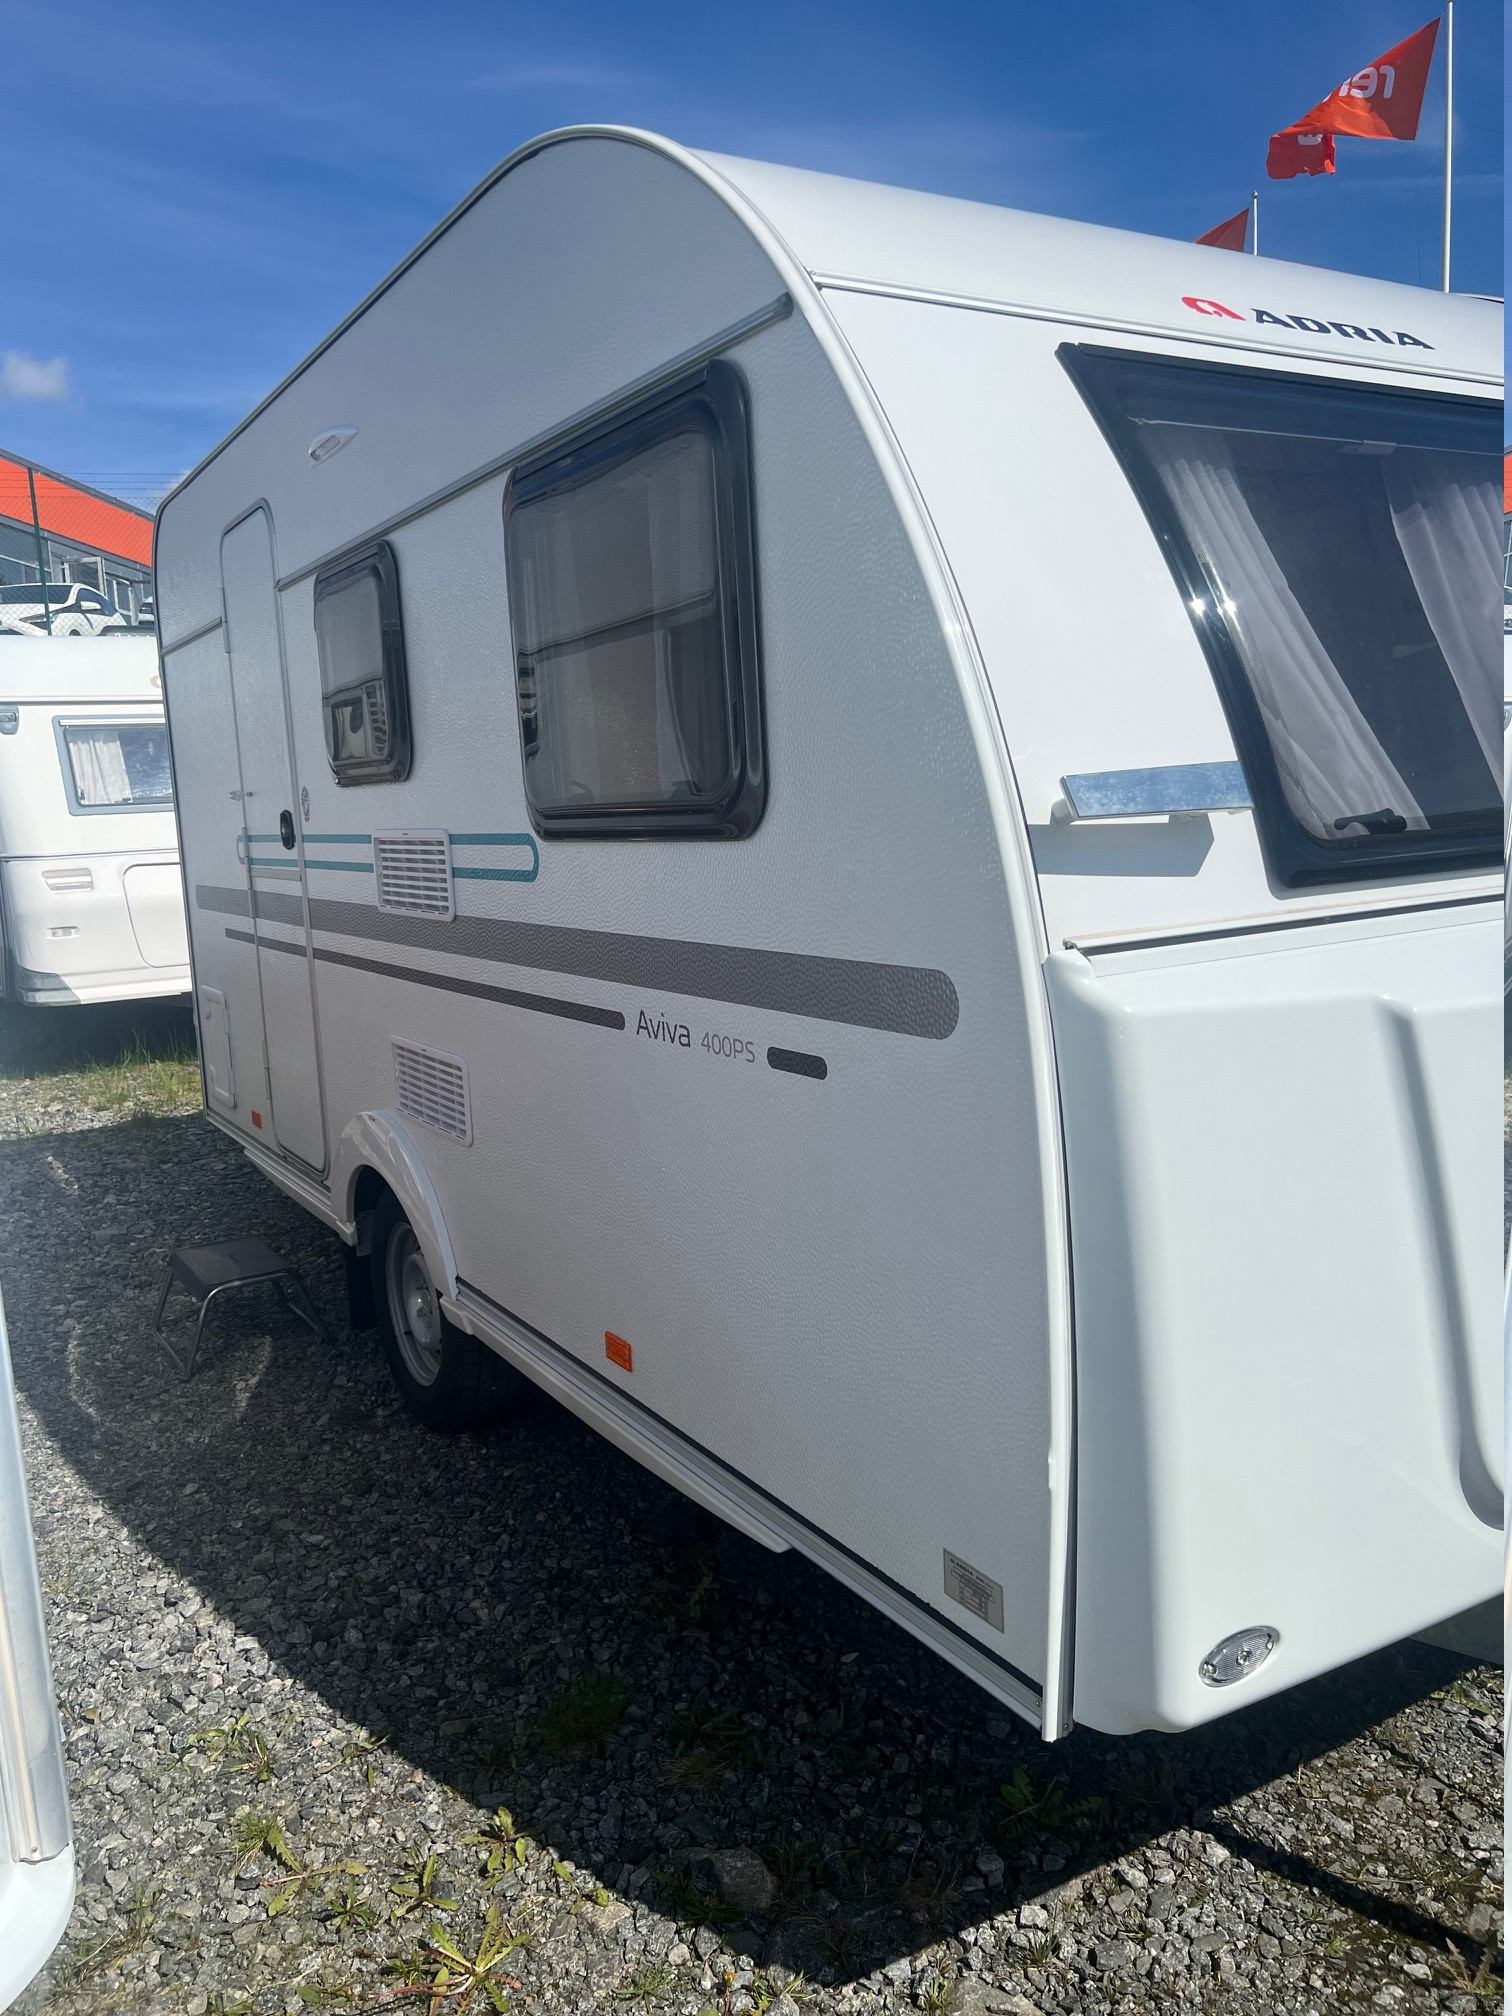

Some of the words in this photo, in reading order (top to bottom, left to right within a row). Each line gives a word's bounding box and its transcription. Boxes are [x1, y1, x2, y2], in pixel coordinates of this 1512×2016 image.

[1251, 308, 1435, 350] ADRIA
[636, 1010, 691, 1048] Aviva
[701, 1032, 755, 1063] 400PS
